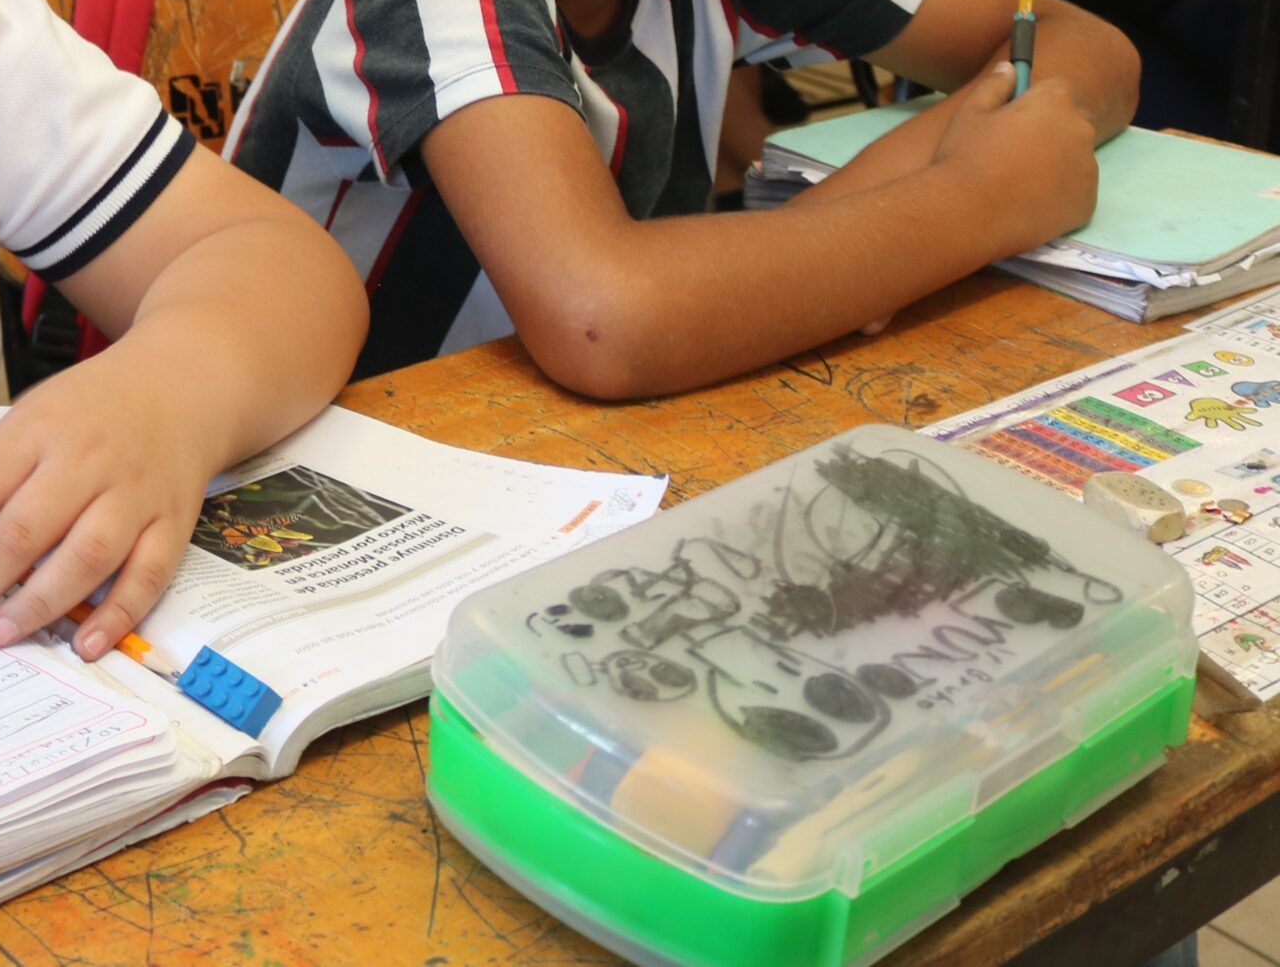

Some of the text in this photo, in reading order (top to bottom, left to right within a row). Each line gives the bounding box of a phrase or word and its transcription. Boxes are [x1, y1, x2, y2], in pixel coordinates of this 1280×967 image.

[274, 513, 432, 576] México por pesticidas
[285, 520, 446, 585] mariposas Monarca en
[293, 526, 465, 594] Disminuye presencia de
